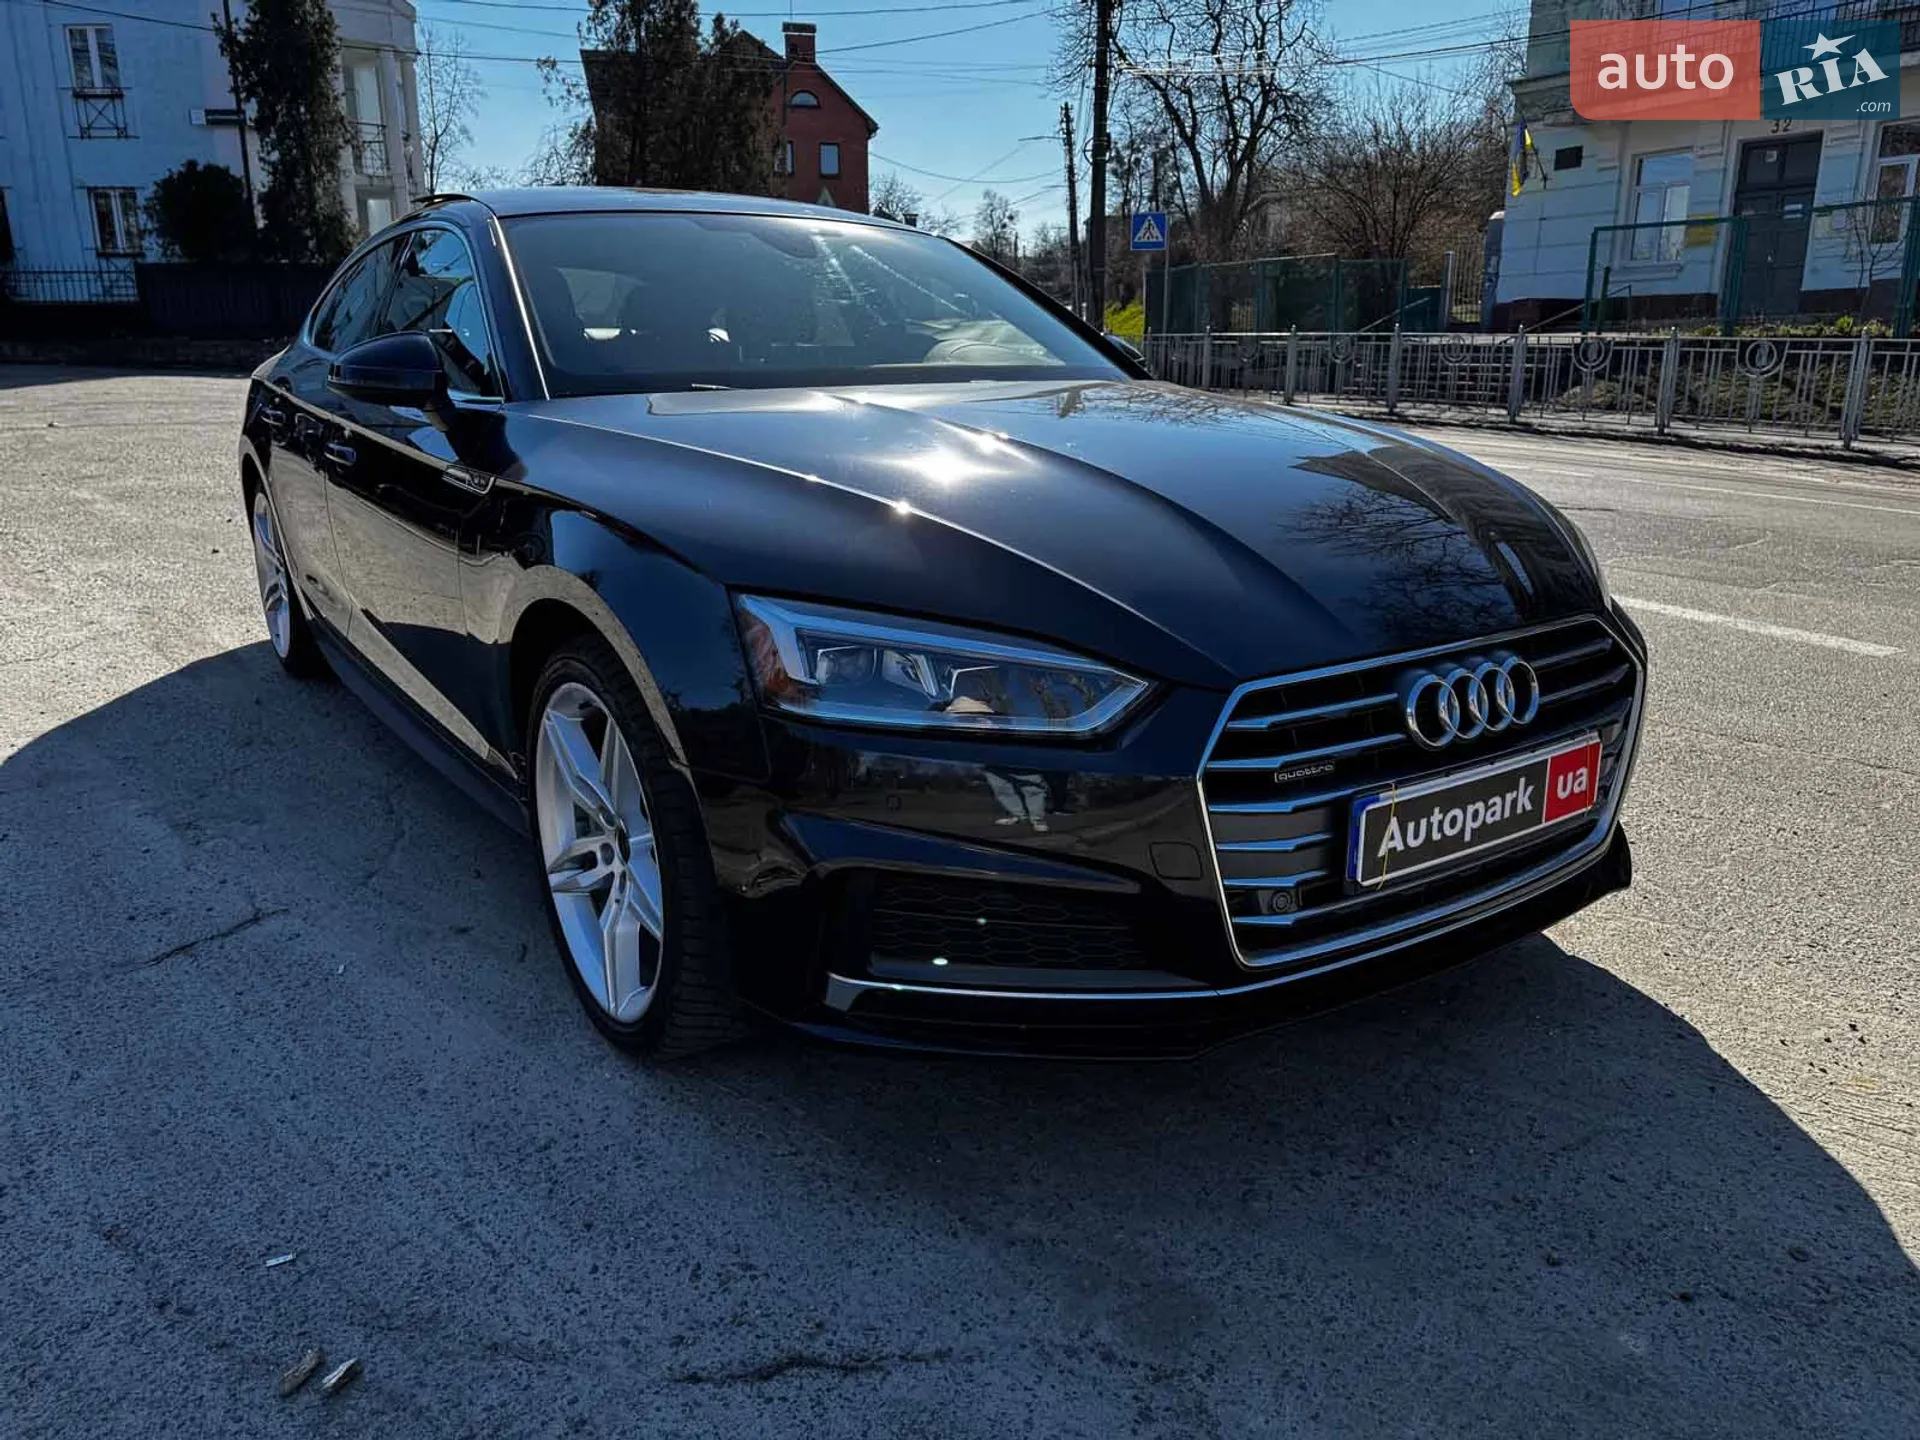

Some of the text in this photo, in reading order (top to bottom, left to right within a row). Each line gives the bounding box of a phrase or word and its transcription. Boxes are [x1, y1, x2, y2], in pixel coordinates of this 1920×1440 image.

[1769, 117, 1792, 133] 32
[1278, 764, 1334, 780] quattro
[1377, 767, 1588, 858] Autopark ua
